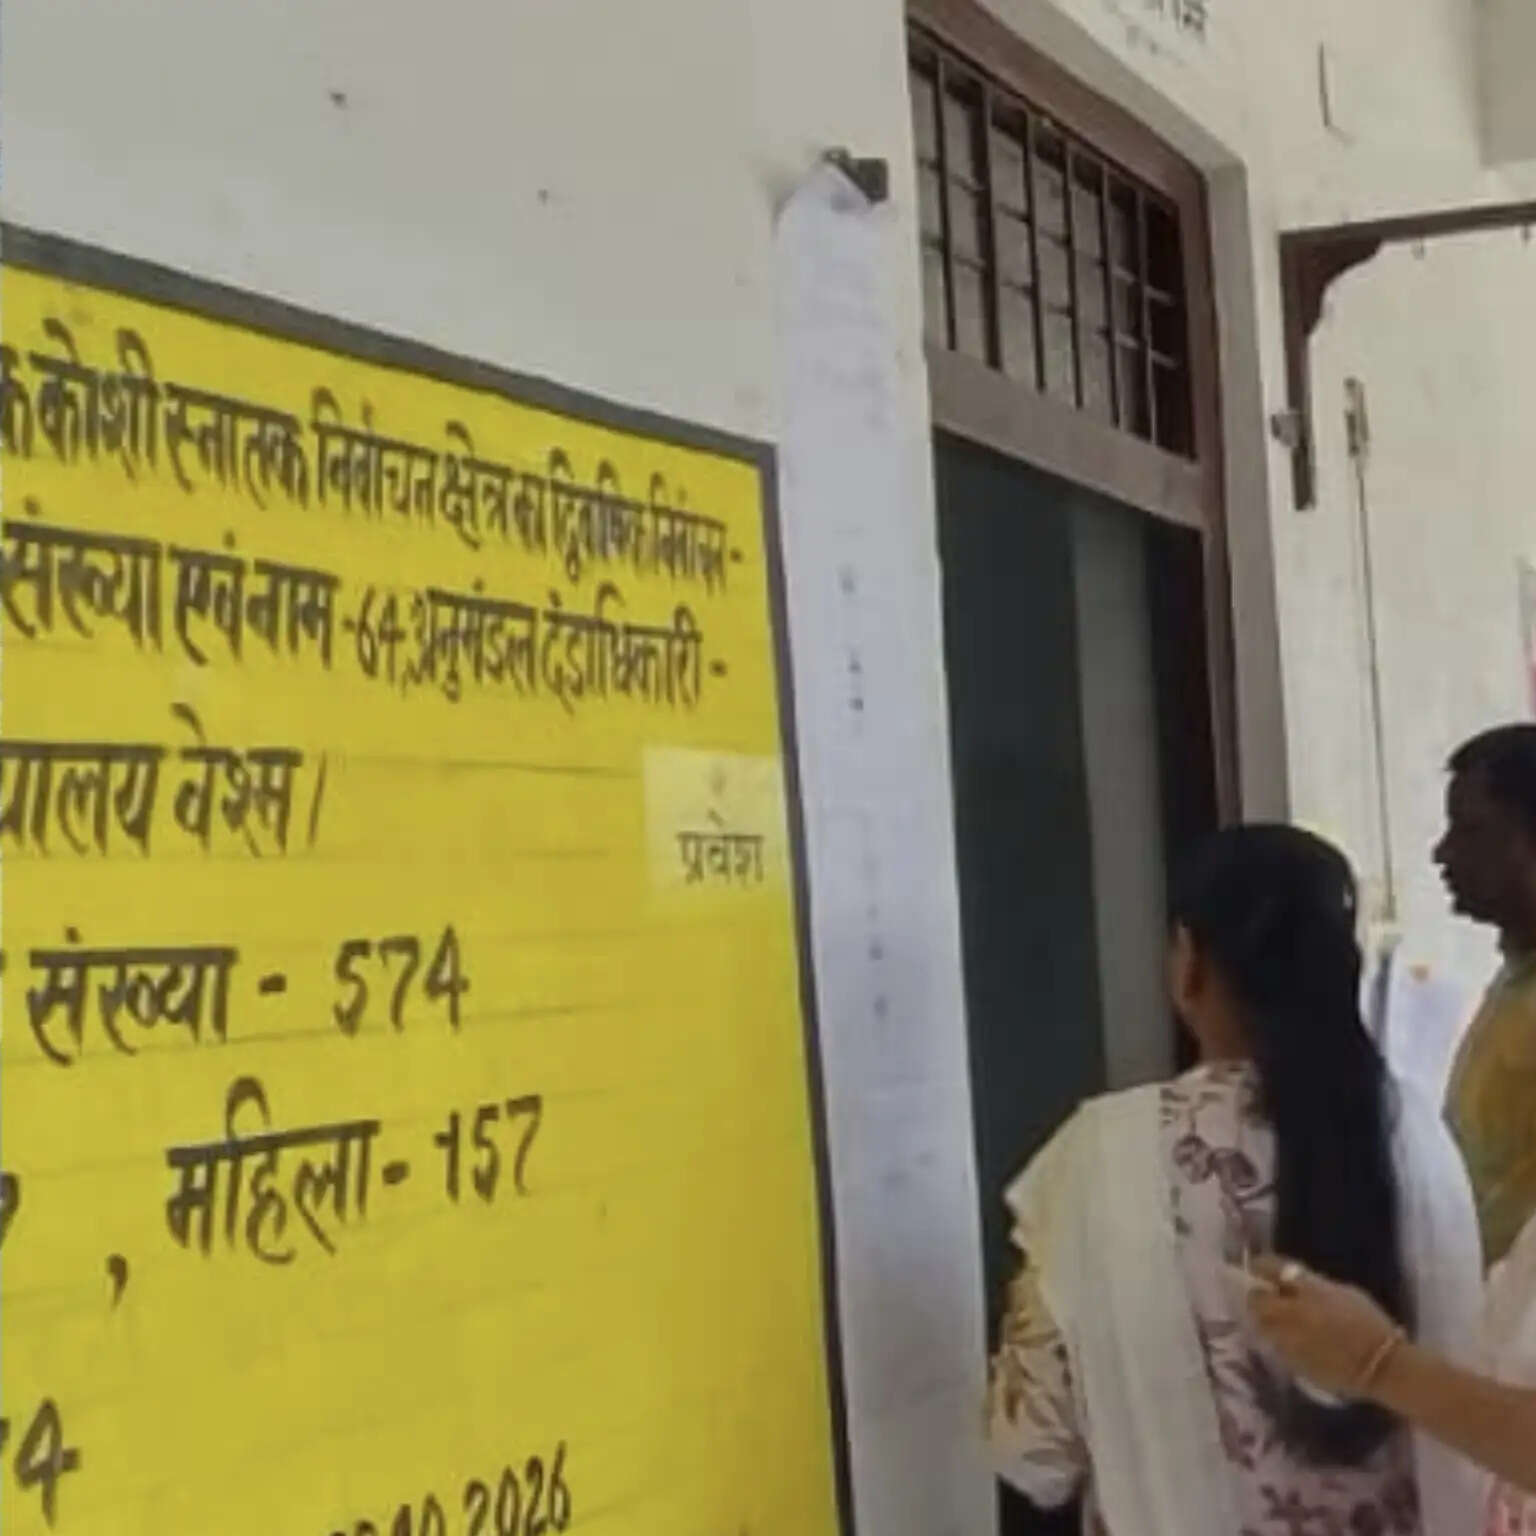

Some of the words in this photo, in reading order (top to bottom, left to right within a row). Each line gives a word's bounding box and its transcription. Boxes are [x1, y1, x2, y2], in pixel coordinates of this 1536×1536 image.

[677, 816, 764, 884] प्रवेश
[26, 927, 236, 1067] संख्या
[331, 926, 470, 1038] 574
